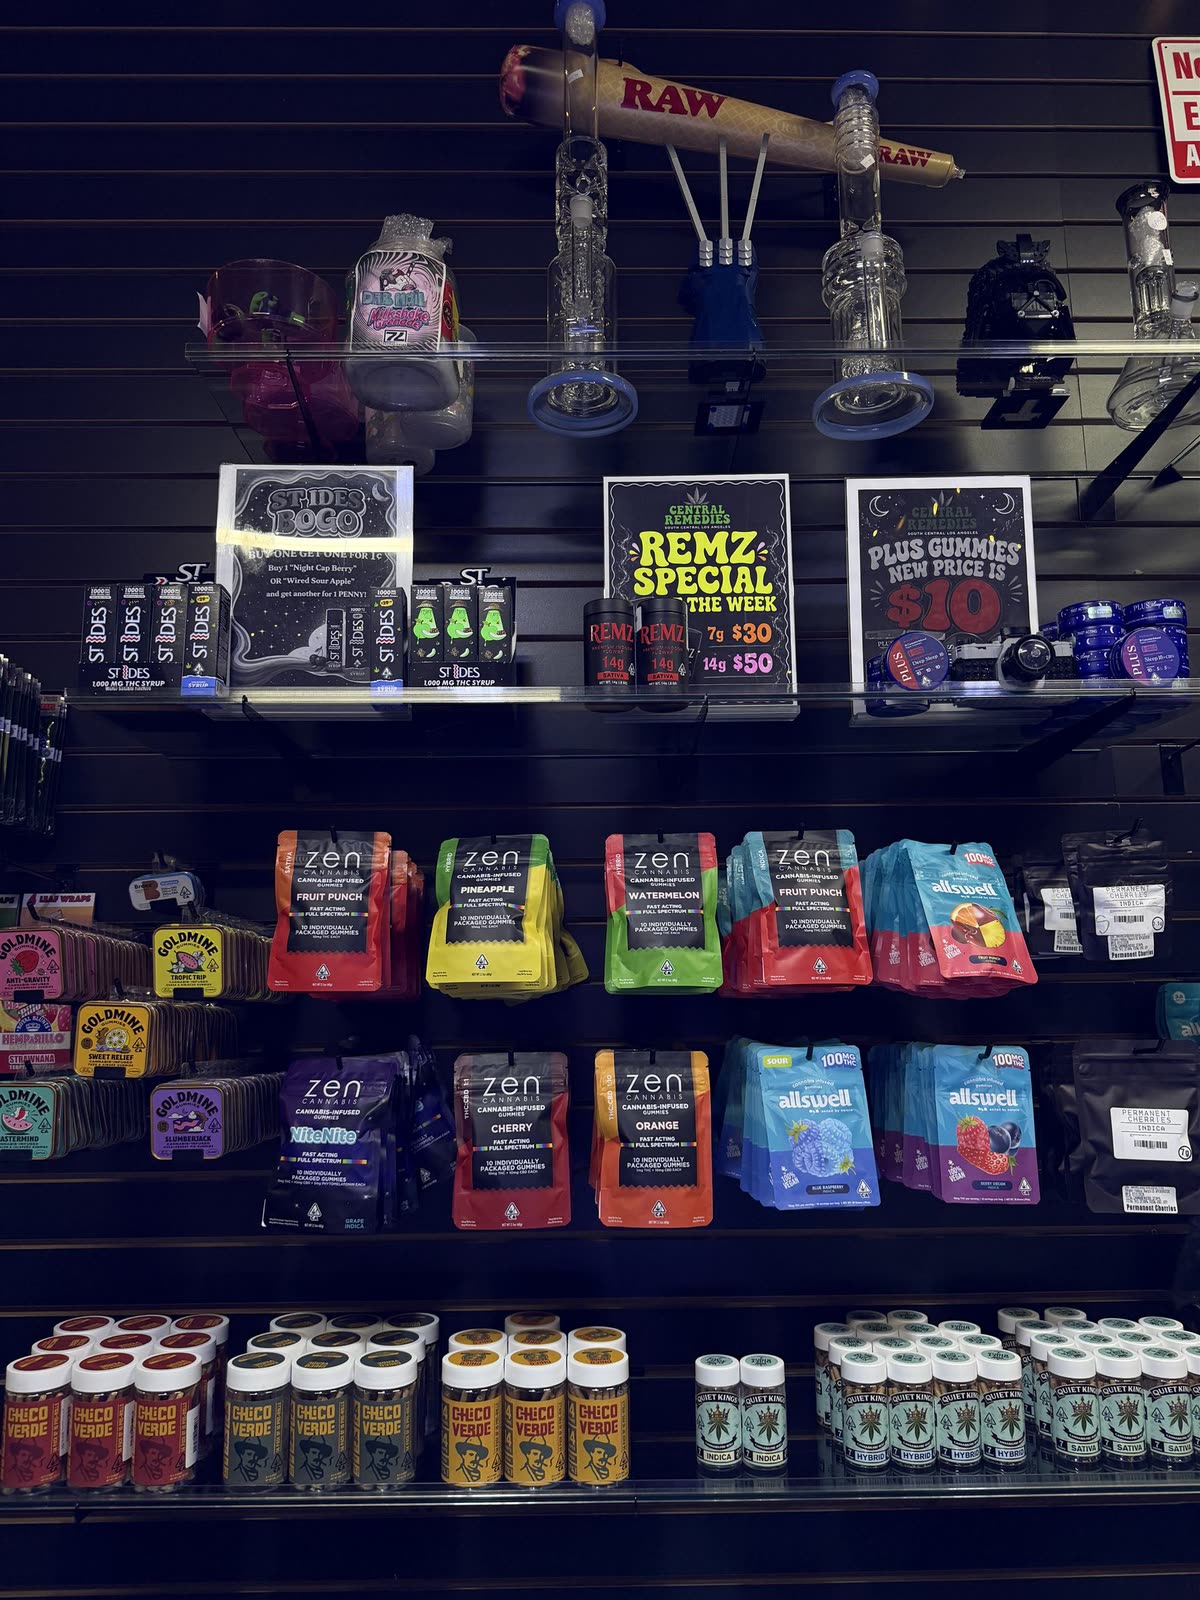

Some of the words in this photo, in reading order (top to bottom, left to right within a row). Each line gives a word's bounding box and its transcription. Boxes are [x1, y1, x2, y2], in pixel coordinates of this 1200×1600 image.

[621, 77, 727, 118] RAW
[878, 146, 932, 167] RAW
[369, 307, 430, 324] Milkshake
[374, 318, 423, 330] Grenade
[310, 489, 364, 508] IDES
[669, 505, 725, 514] CENTRAL
[912, 506, 972, 518] CENTRAL
[274, 508, 361, 536] BOGO
[665, 515, 730, 525] REMEDIES
[907, 518, 977, 530] REMEDIES
[639, 531, 757, 567] REMZ
[868, 539, 924, 570] PLUS
[928, 537, 1020, 565] GUMMIES
[268, 564, 282, 572] Buy
[290, 564, 313, 572] "Night
[316, 565, 329, 573] Cap
[331, 565, 357, 573] Berry"
[888, 560, 928, 583] NEW
[933, 559, 982, 576] PRICE
[988, 563, 1006, 581] IS
[330, 578, 355, 586] Apple"
[633, 566, 773, 596] SPECIAL
[687, 597, 722, 612] THE
[725, 596, 777, 612] WEEK
[886, 578, 1001, 633] $10
[590, 623, 634, 643] REMZ
[640, 624, 685, 645] REMZ
[707, 626, 724, 642] 7g
[732, 623, 772, 643] $30
[603, 656, 624, 670] 14g
[653, 658, 673, 671] 14g
[704, 657, 726, 672] 14g
[734, 653, 773, 674] $50
[893, 652, 912, 682] PLUS
[1127, 645, 1142, 675] PLUS
[306, 851, 361, 869] zen
[466, 850, 518, 868] zen
[635, 852, 689, 868] zen
[776, 849, 829, 867] zen
[461, 886, 515, 894] PINEAPPLE
[629, 892, 699, 900] WATERMELON
[932, 880, 998, 896] allswell
[61, 895, 91, 903] WRAPS
[297, 893, 326, 901] FRUIT
[328, 893, 363, 901] PUNCH
[159, 931, 219, 957] GOLDMINE
[82, 1008, 145, 1035] GOLDMINE
[88, 1053, 109, 1061] SWEET
[822, 1053, 843, 1067] 100
[993, 1054, 1012, 1067] 100
[304, 1079, 360, 1097] zen
[484, 1076, 540, 1096] zen
[627, 1074, 682, 1092] zen
[156, 1091, 219, 1118] GOLDMINE
[779, 1089, 852, 1109] allswell
[950, 1088, 1018, 1106] allswell
[491, 1123, 532, 1133] CHERRY
[636, 1121, 679, 1130] ORANGE
[289, 1126, 358, 1145] NiteNite
[697, 1394, 717, 1402] QUIET
[718, 1394, 738, 1403] KINGS
[8, 1421, 48, 1438] VERDE
[298, 1420, 335, 1436] VERDE
[516, 1421, 554, 1437] VERDE
[857, 1452, 885, 1460] HYBRID
[1071, 1444, 1097, 1452] SATIVA
